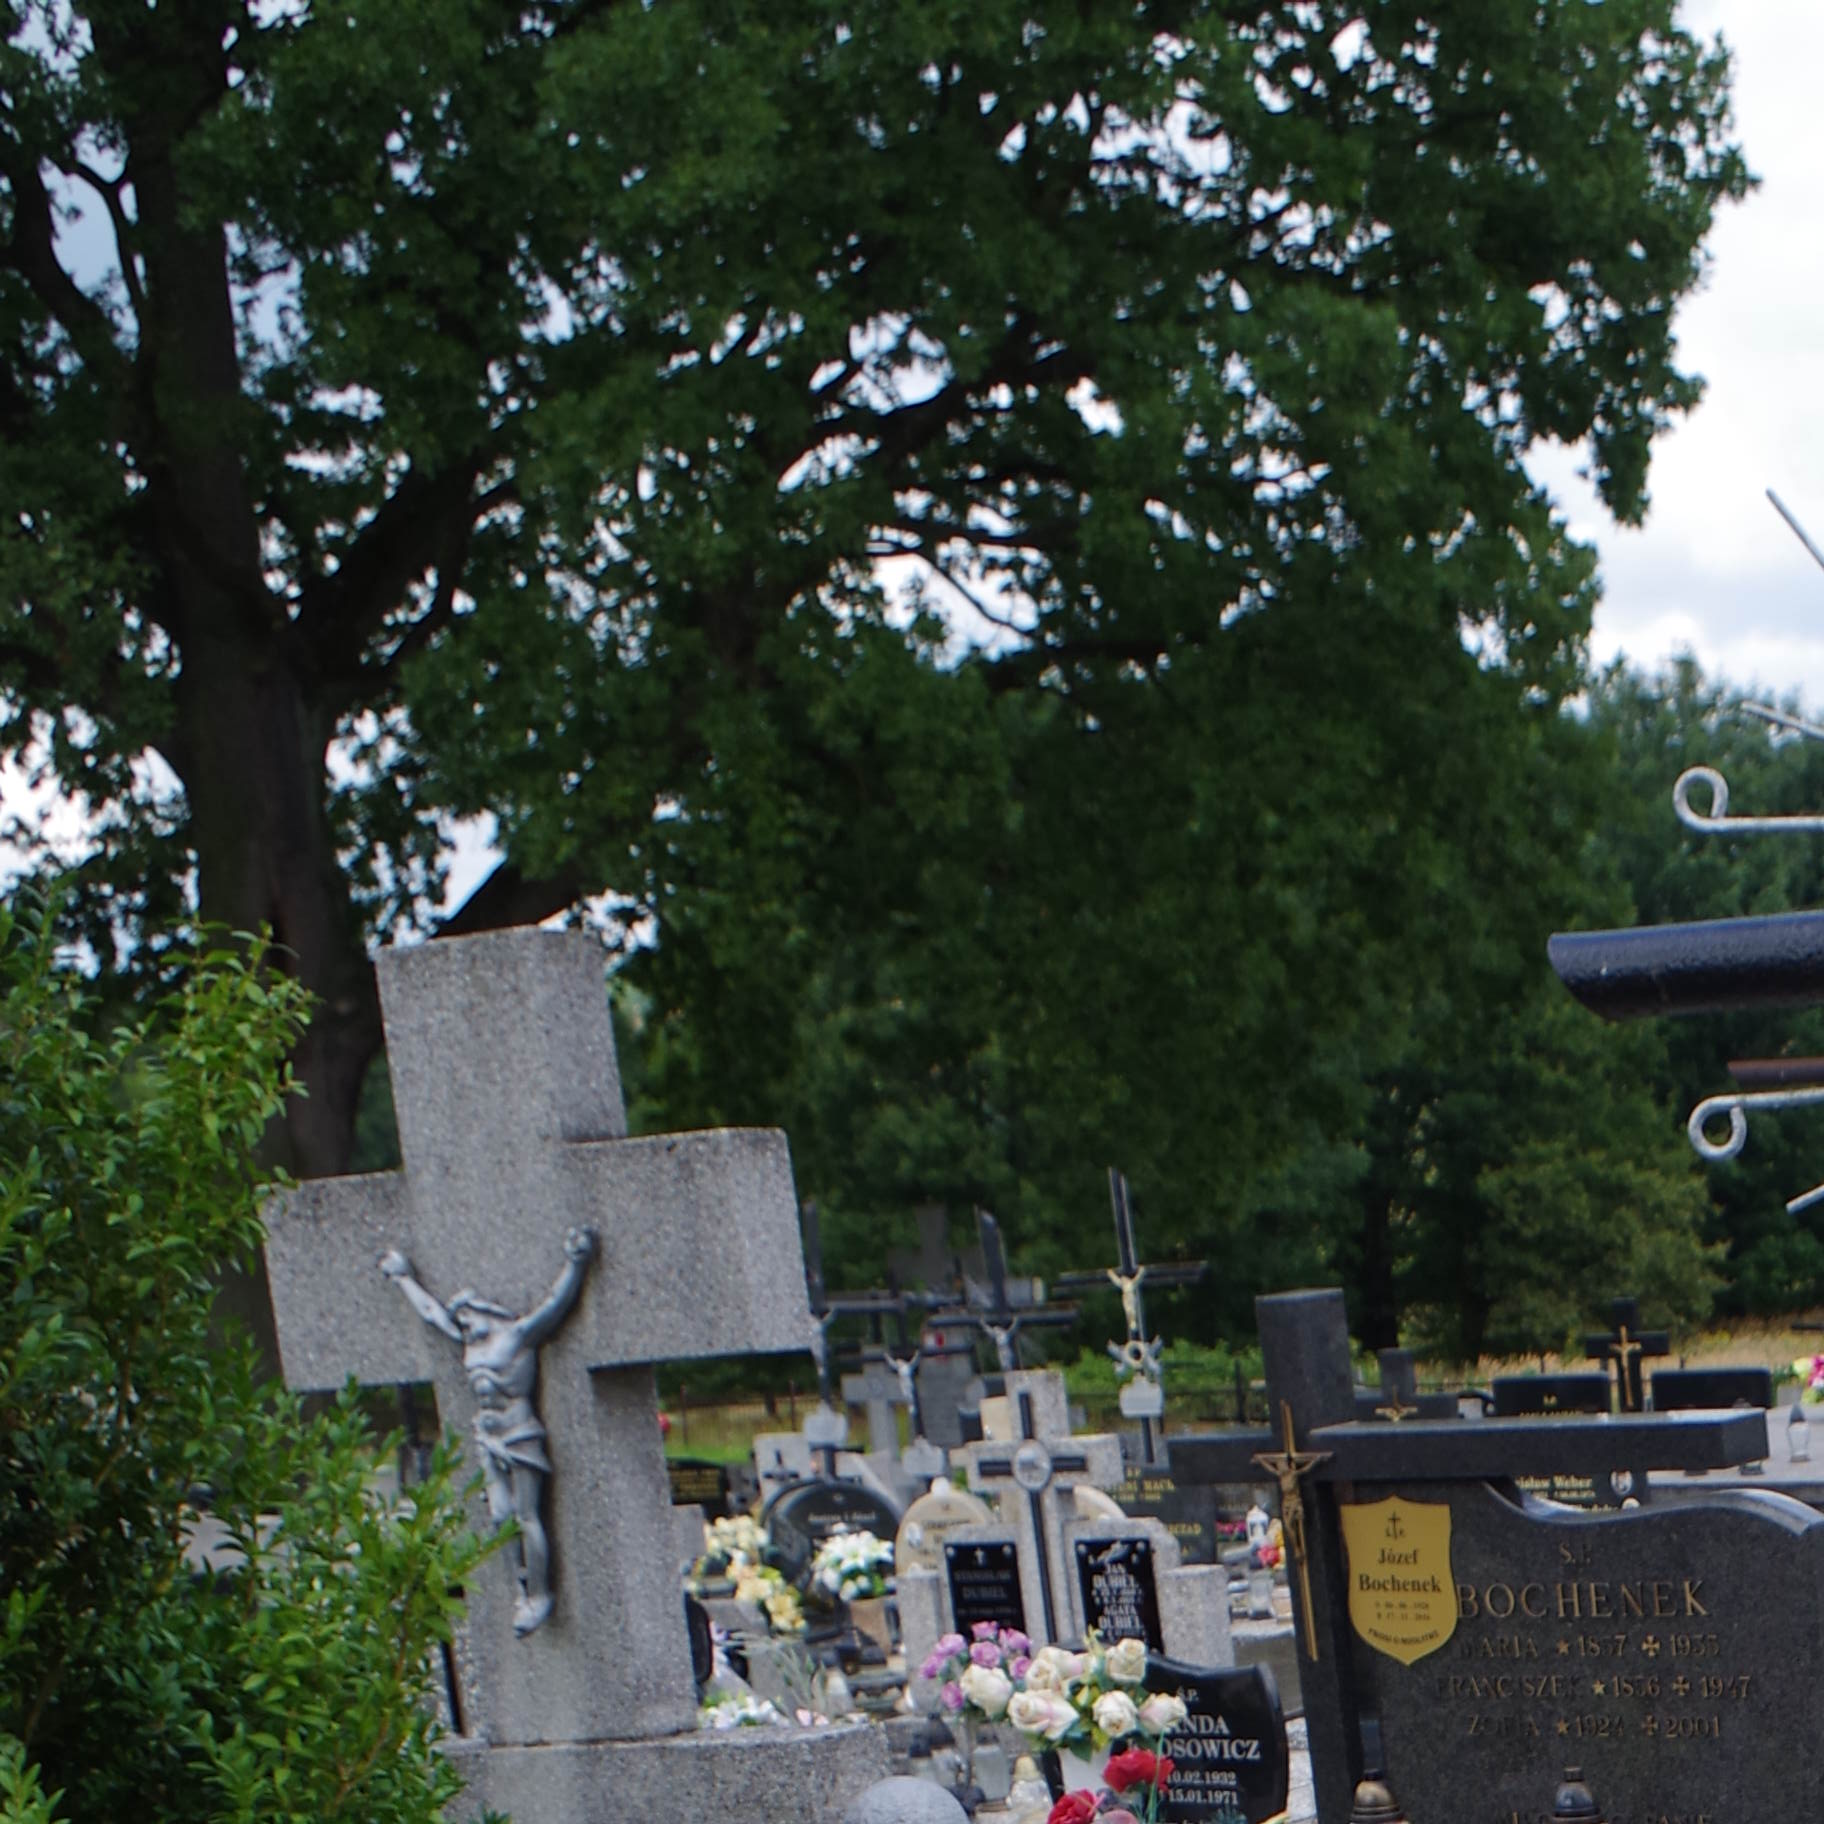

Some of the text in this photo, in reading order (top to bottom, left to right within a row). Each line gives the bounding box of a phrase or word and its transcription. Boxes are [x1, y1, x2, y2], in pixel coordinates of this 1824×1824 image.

[1377, 1547, 1419, 1565] Józef
[1358, 1573, 1442, 1593] Bochenek
[1456, 1578, 1711, 1618] BOCHENEK
[1664, 1712, 1720, 1739] 2001
